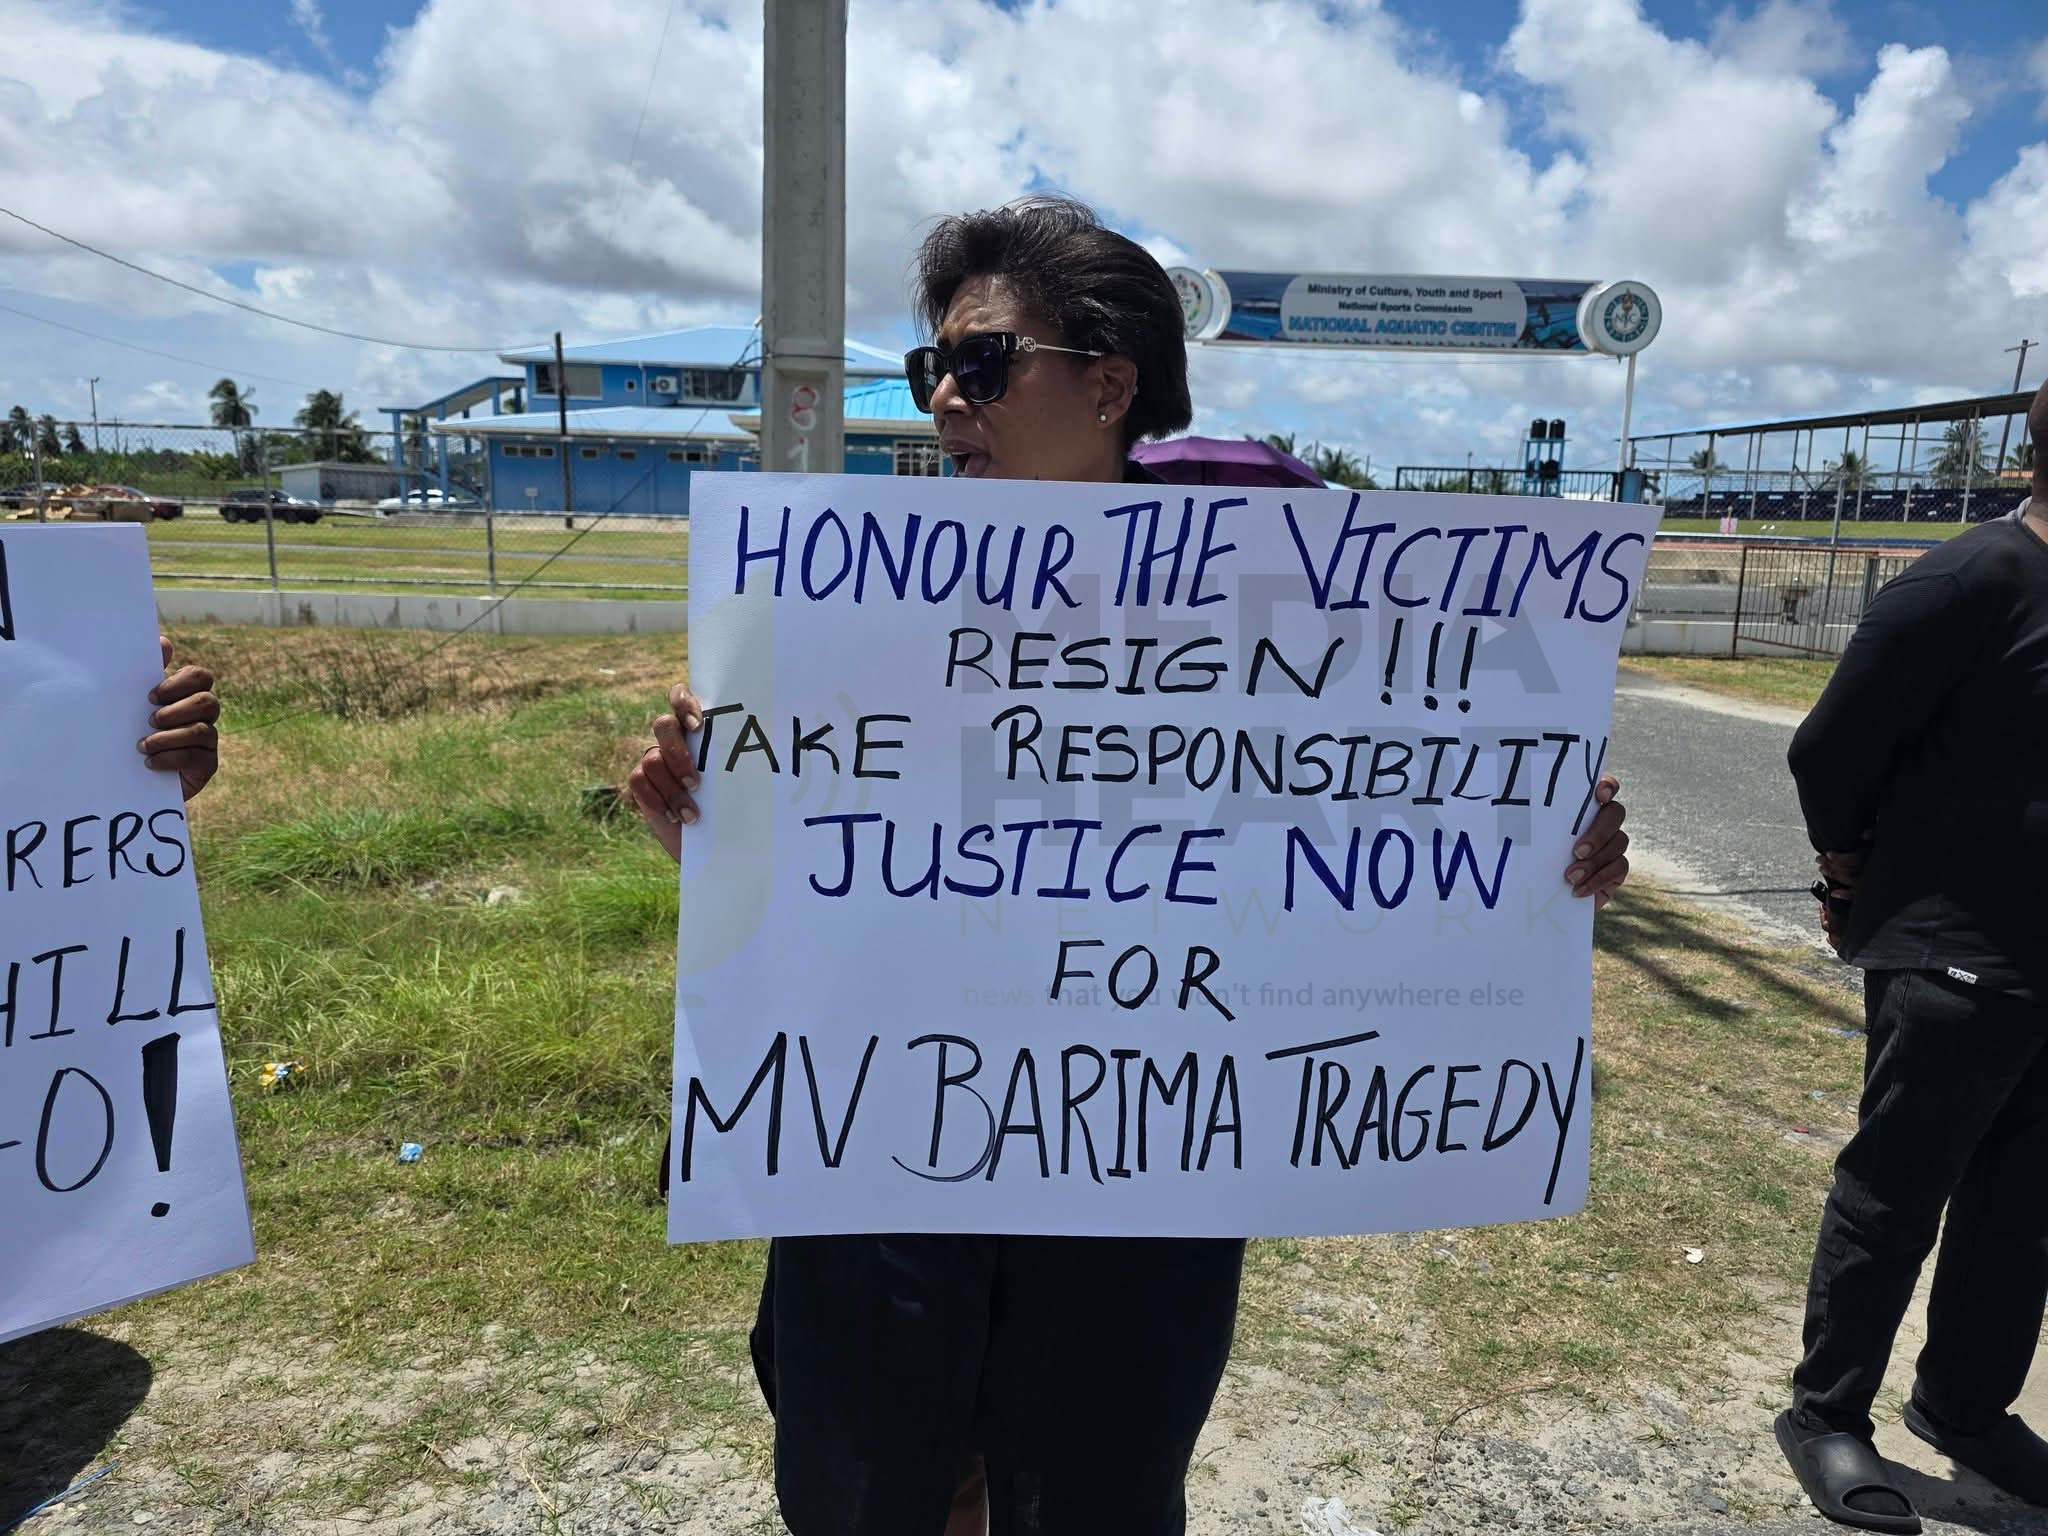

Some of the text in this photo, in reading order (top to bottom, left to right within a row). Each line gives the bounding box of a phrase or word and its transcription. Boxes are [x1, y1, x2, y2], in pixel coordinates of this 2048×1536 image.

[1288, 316, 1372, 333] NATIONAL
[1374, 318, 1448, 335] AQUATIC
[1307, 283, 1503, 300] Ministry of Culture, Youth and Sport
[1338, 301, 1378, 311] National
[735, 493, 1645, 623] HONOUR THE VICTIMS
[946, 627, 1345, 699] RESIGN
[695, 703, 1608, 835] TAKE RESPONSIBILITY
[7, 808, 186, 892] RERS
[804, 812, 1513, 912] JUSTICE NOW
[1049, 939, 1236, 1022] FOR
[681, 1030, 1585, 1206] MV BARIMA TRAGEDY
